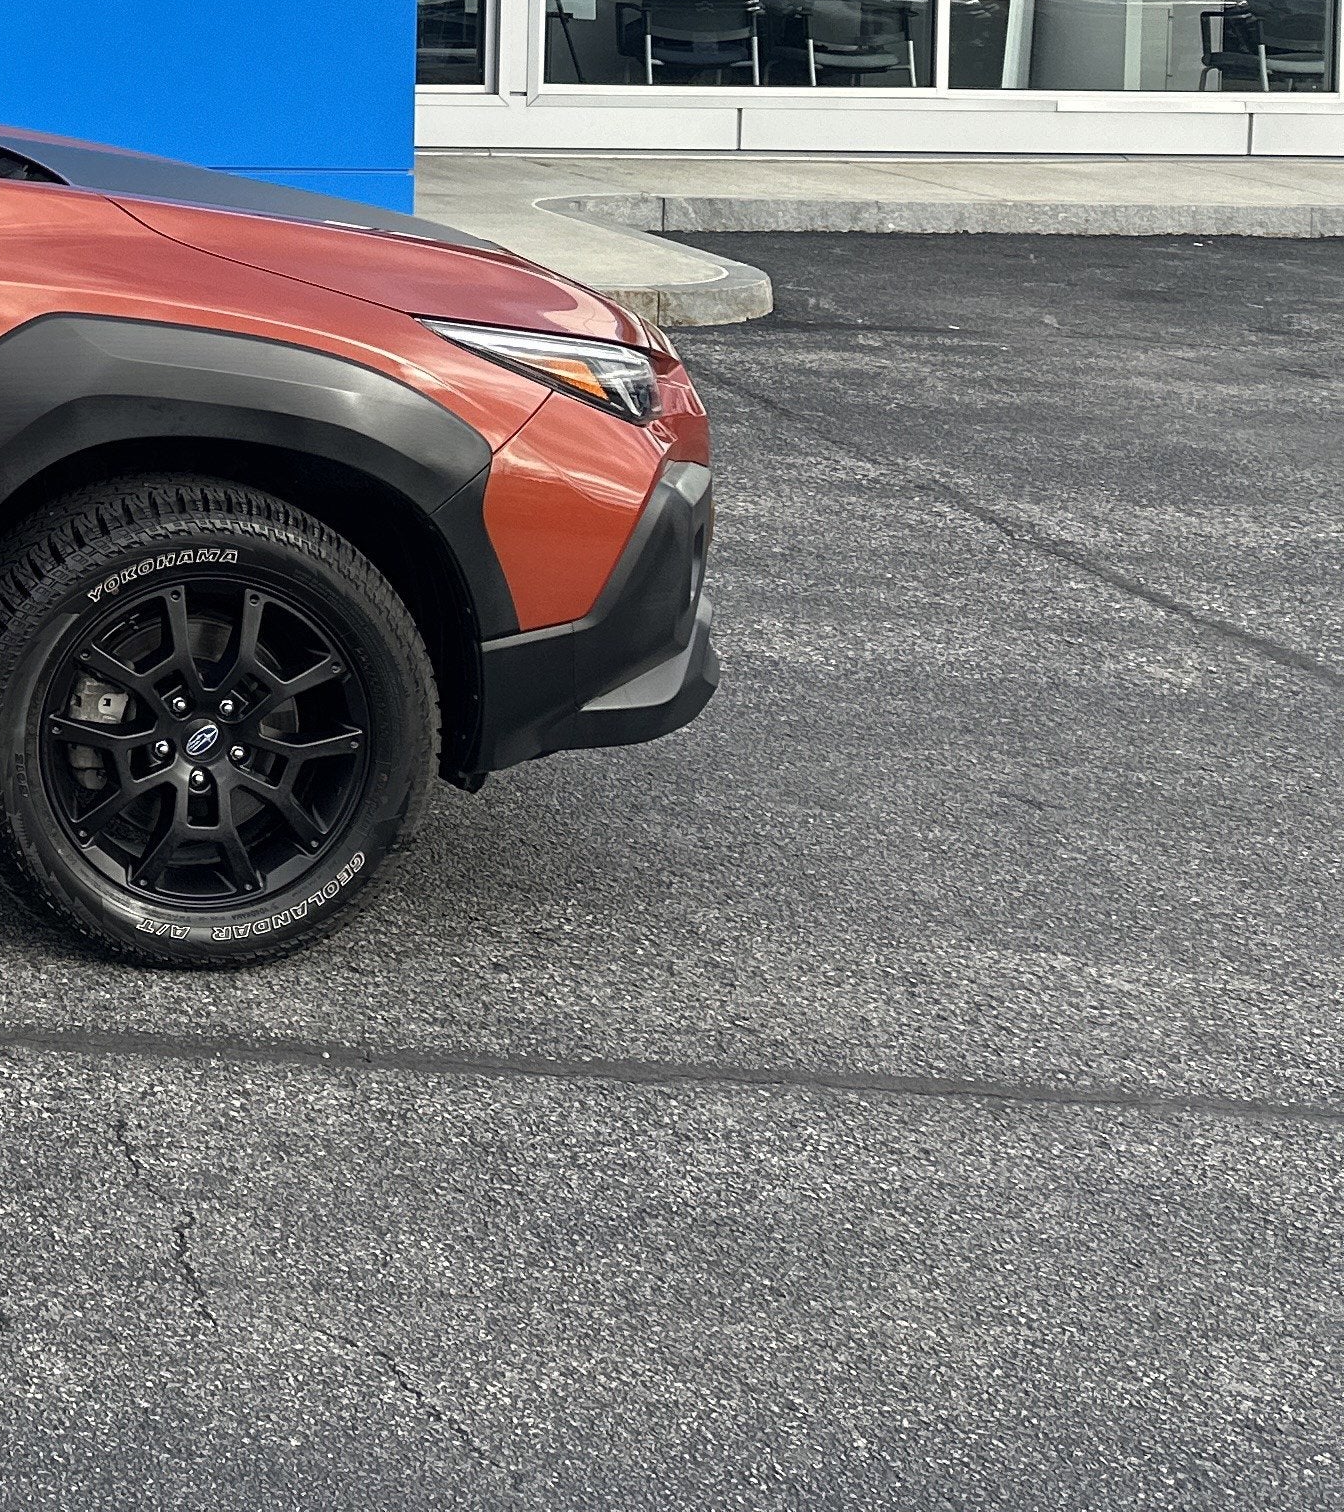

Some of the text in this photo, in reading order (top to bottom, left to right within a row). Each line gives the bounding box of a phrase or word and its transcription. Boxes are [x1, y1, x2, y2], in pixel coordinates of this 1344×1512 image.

[87, 549, 239, 603] YOKOHAMA
[136, 850, 366, 941] GEOLANDAR A/T
